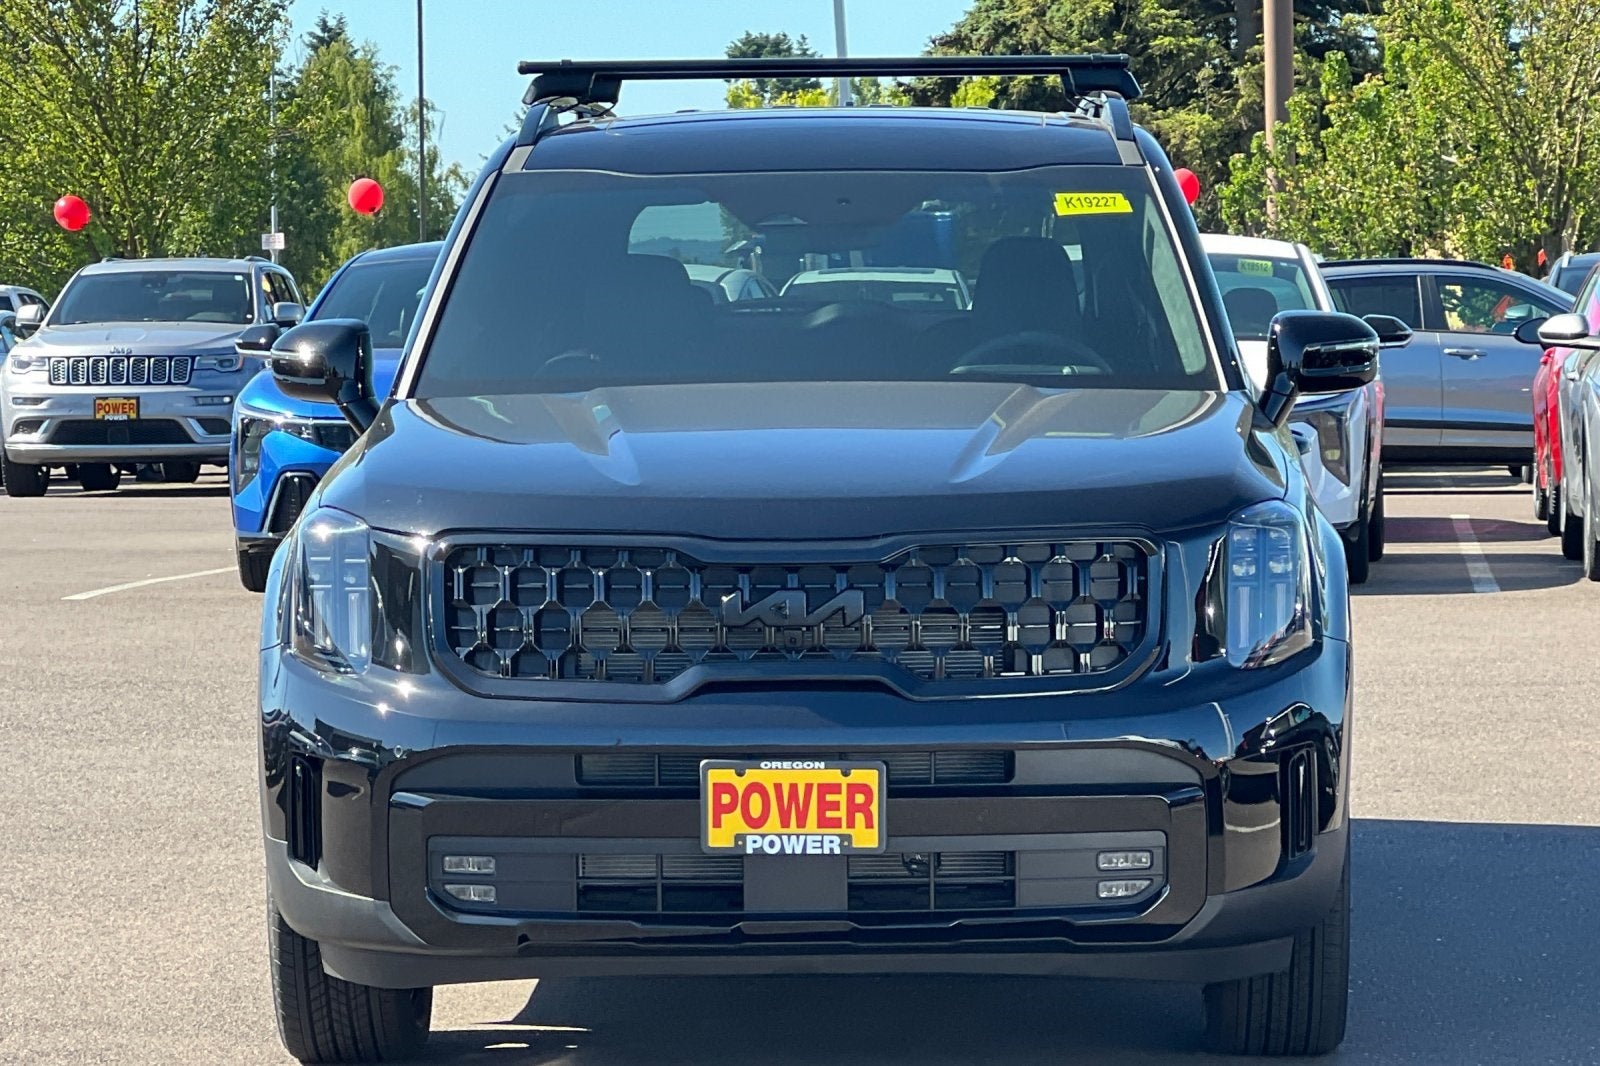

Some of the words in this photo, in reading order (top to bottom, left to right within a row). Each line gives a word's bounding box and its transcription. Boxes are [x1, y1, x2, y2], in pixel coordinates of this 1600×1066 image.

[1063, 196, 1118, 208] K19227
[97, 402, 135, 414] POWER
[760, 761, 825, 769] OREGON
[712, 781, 875, 830] POWER
[745, 834, 841, 855] POWER
